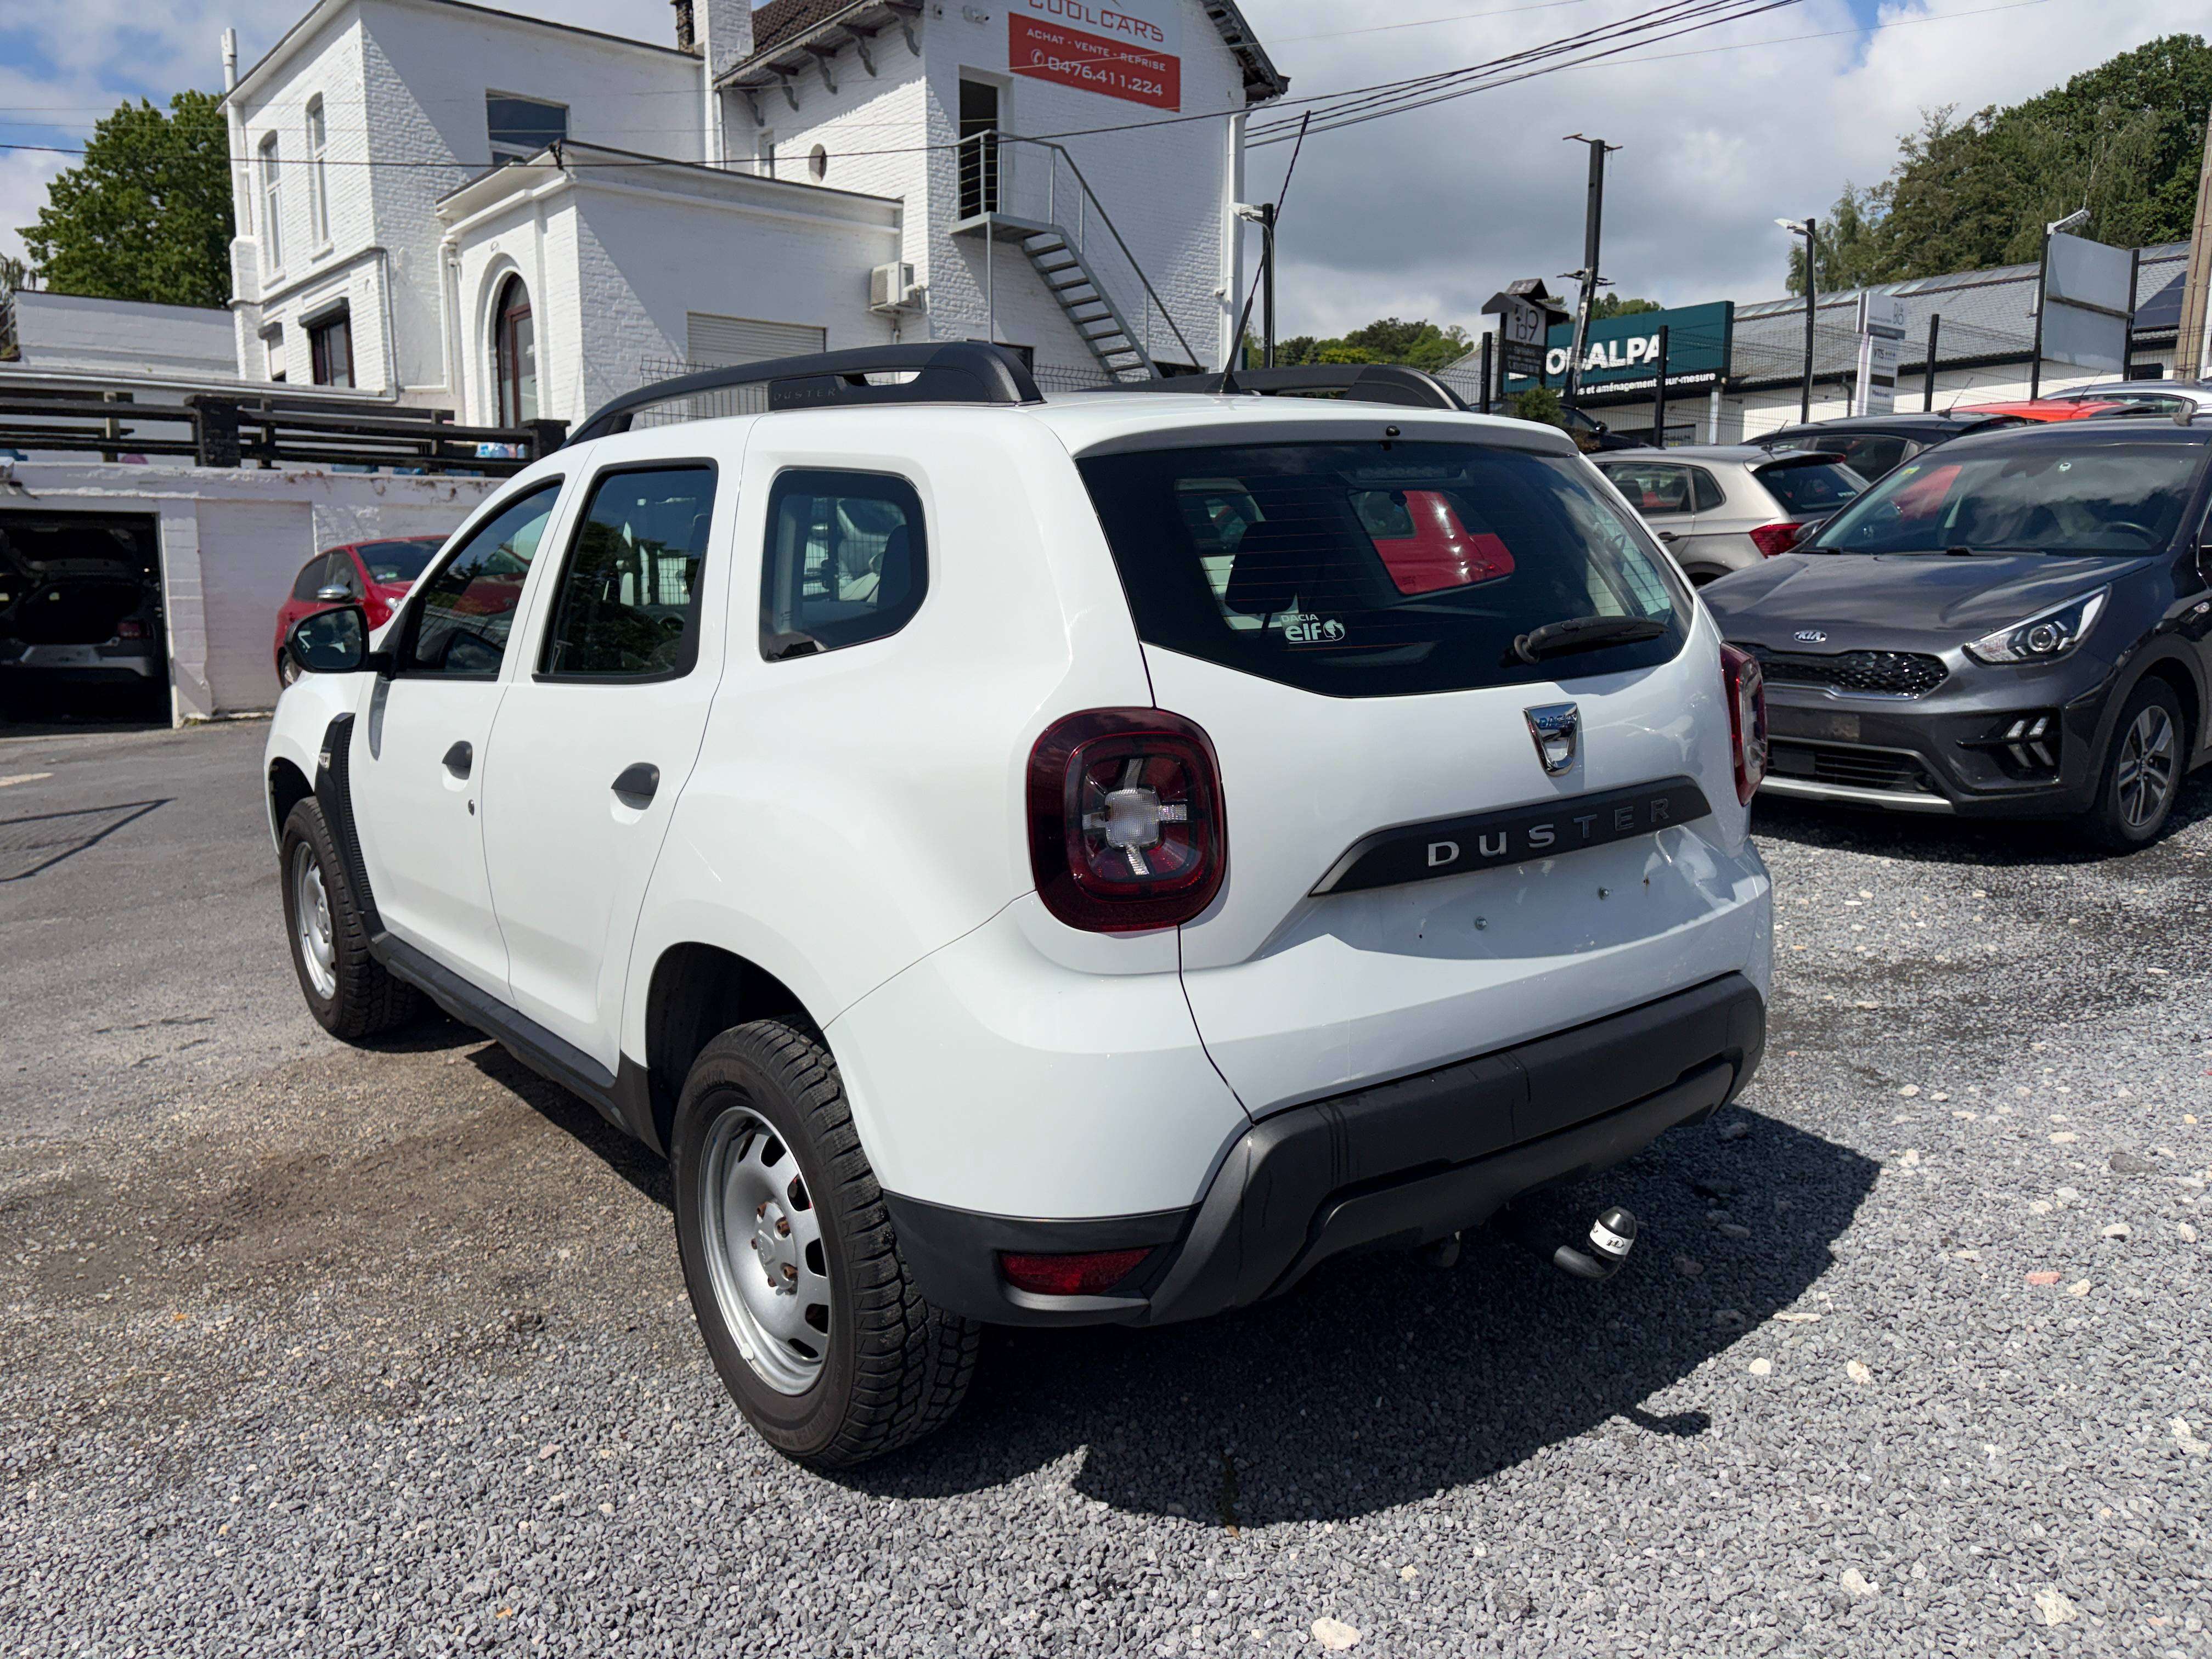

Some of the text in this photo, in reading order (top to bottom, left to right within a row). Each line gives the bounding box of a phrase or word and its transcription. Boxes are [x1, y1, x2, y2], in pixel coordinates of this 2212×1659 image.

[1026, 28, 1064, 45] ACHAT
[1074, 41, 1110, 57] VENTE
[1120, 53, 1166, 71] REPRISE
[1048, 56, 1163, 96] 0476.411.224
[774, 388, 836, 401] DUSTER
[1281, 614, 1318, 622] DACIA
[1285, 622, 1322, 641] elf
[1797, 631, 1822, 641] KIA
[1428, 798, 1669, 867] DUSTER
